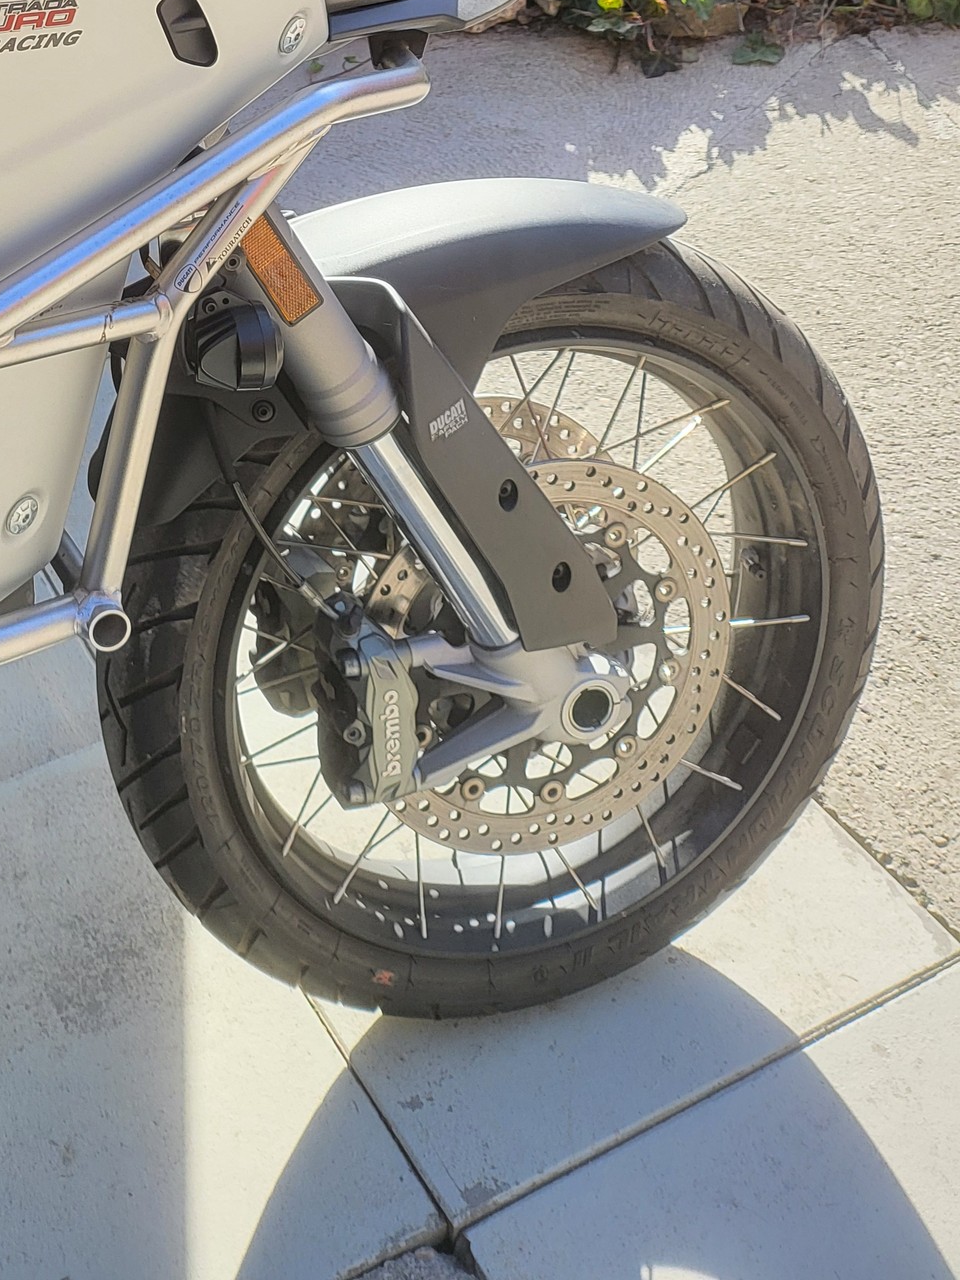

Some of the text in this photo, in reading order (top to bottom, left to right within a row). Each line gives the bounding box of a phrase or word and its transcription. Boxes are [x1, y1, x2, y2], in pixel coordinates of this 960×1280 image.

[193, 200, 241, 264] PERFORMANCE
[216, 216, 254, 261] TOURATECH
[176, 266, 194, 287] DUCATI
[429, 397, 466, 435] DUCATI
[379, 690, 401, 777] brembo
